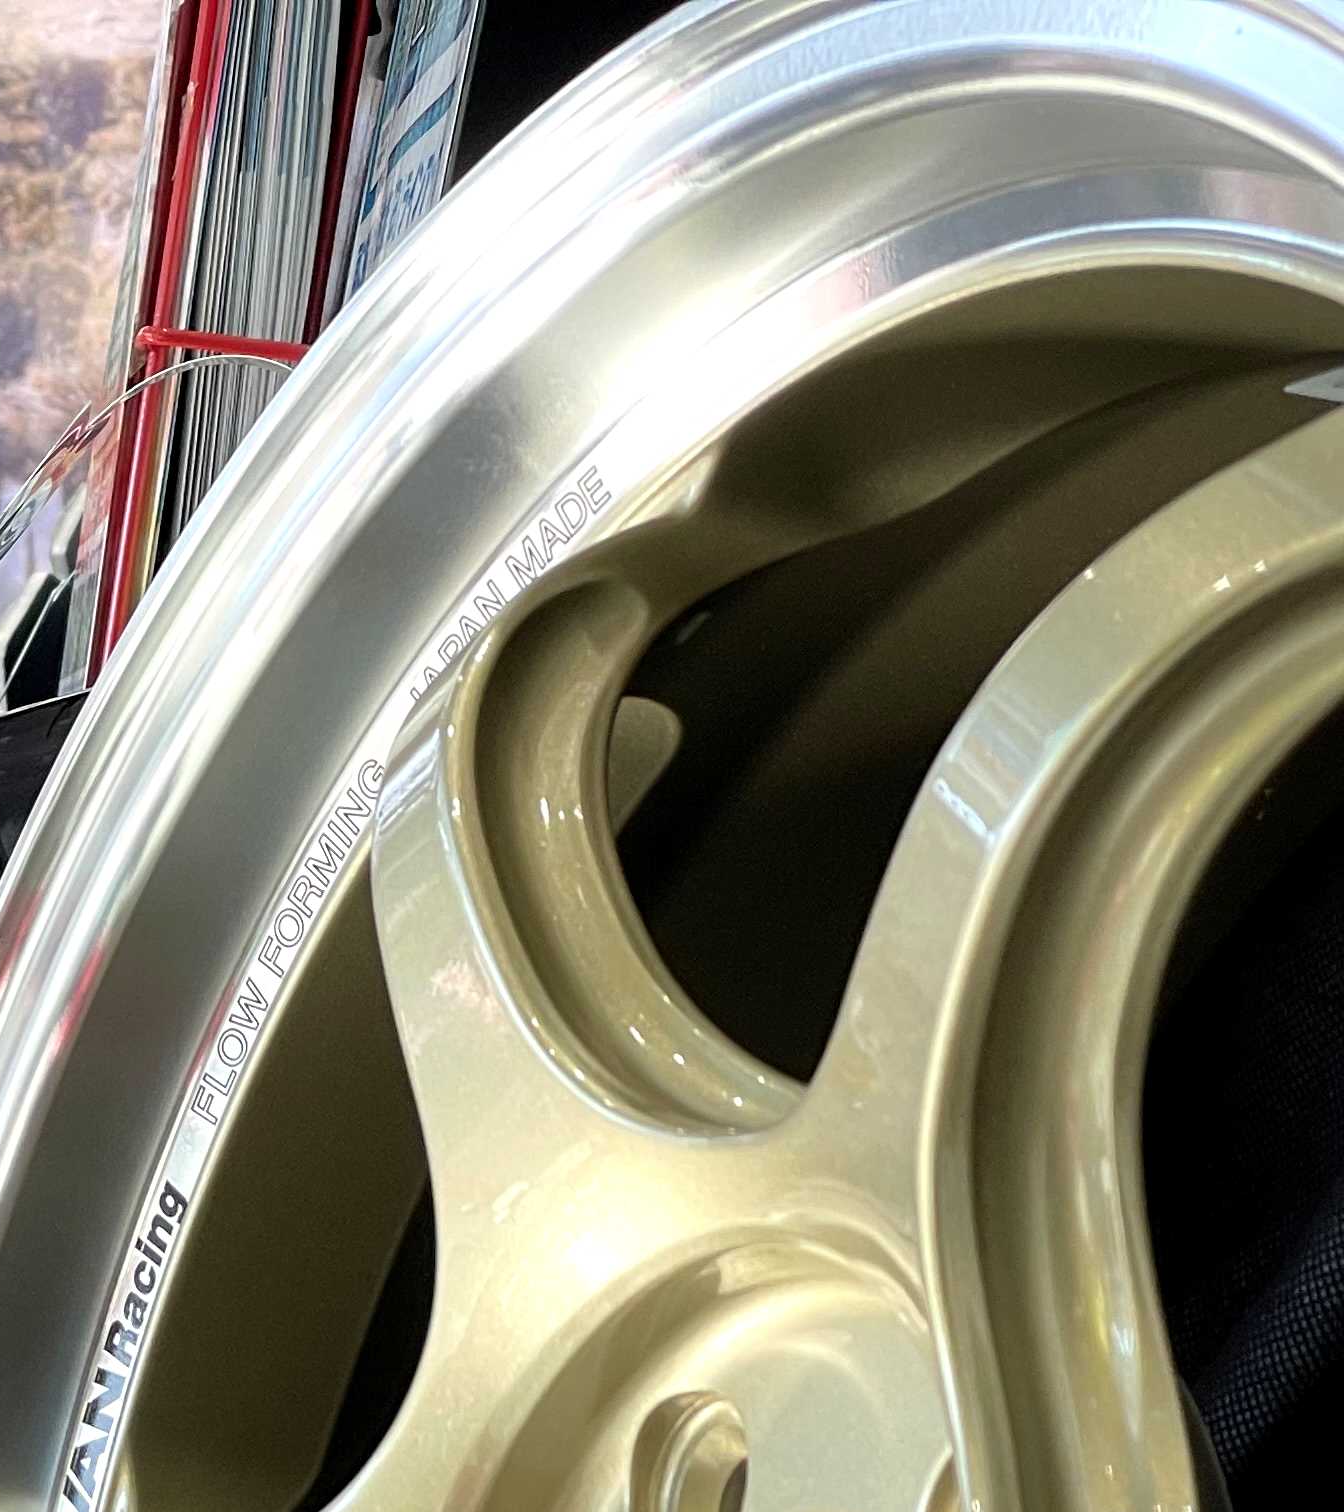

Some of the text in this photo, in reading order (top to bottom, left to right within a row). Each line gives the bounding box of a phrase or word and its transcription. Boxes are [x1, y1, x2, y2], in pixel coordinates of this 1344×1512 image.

[504, 465, 613, 588] MADE
[191, 758, 387, 1126] FLOW FORMING
[104, 1178, 189, 1370] Racing
